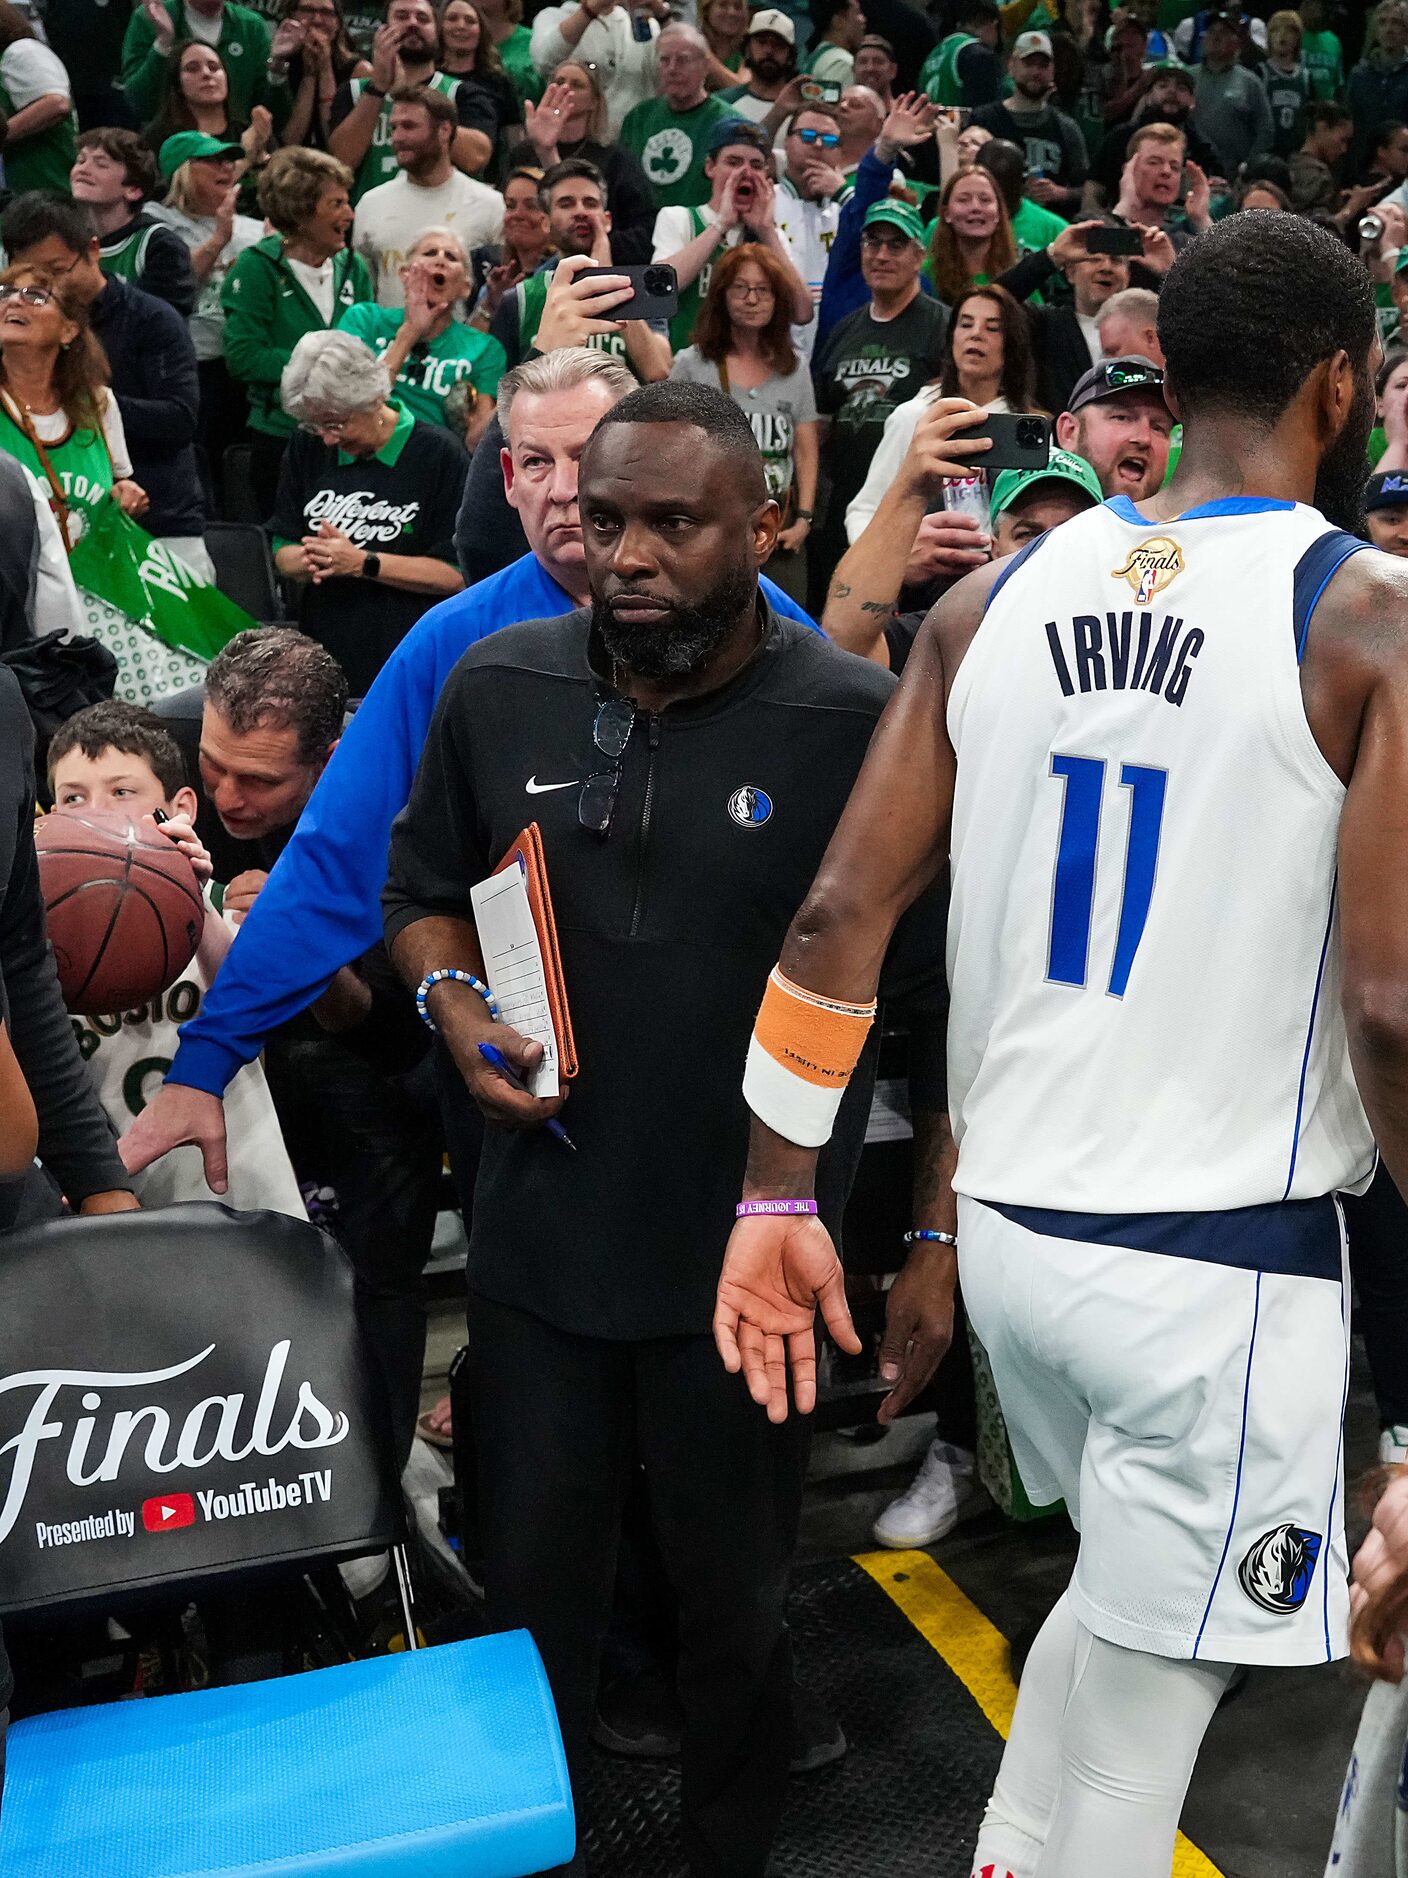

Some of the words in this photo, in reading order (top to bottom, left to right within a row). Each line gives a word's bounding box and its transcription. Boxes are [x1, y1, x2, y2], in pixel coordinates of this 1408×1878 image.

[834, 357, 910, 382] FINALS
[303, 489, 420, 527] Different
[1114, 549, 1180, 575] Finals
[1044, 611, 1205, 707] IRVING
[1043, 752, 1170, 1001] 11
[747, 1201, 793, 1214] JOURNEY
[794, 1201, 810, 1213] THE
[0, 1339, 350, 1545] Finals
[36, 1511, 115, 1548] Presented
[115, 1508, 135, 1538] by
